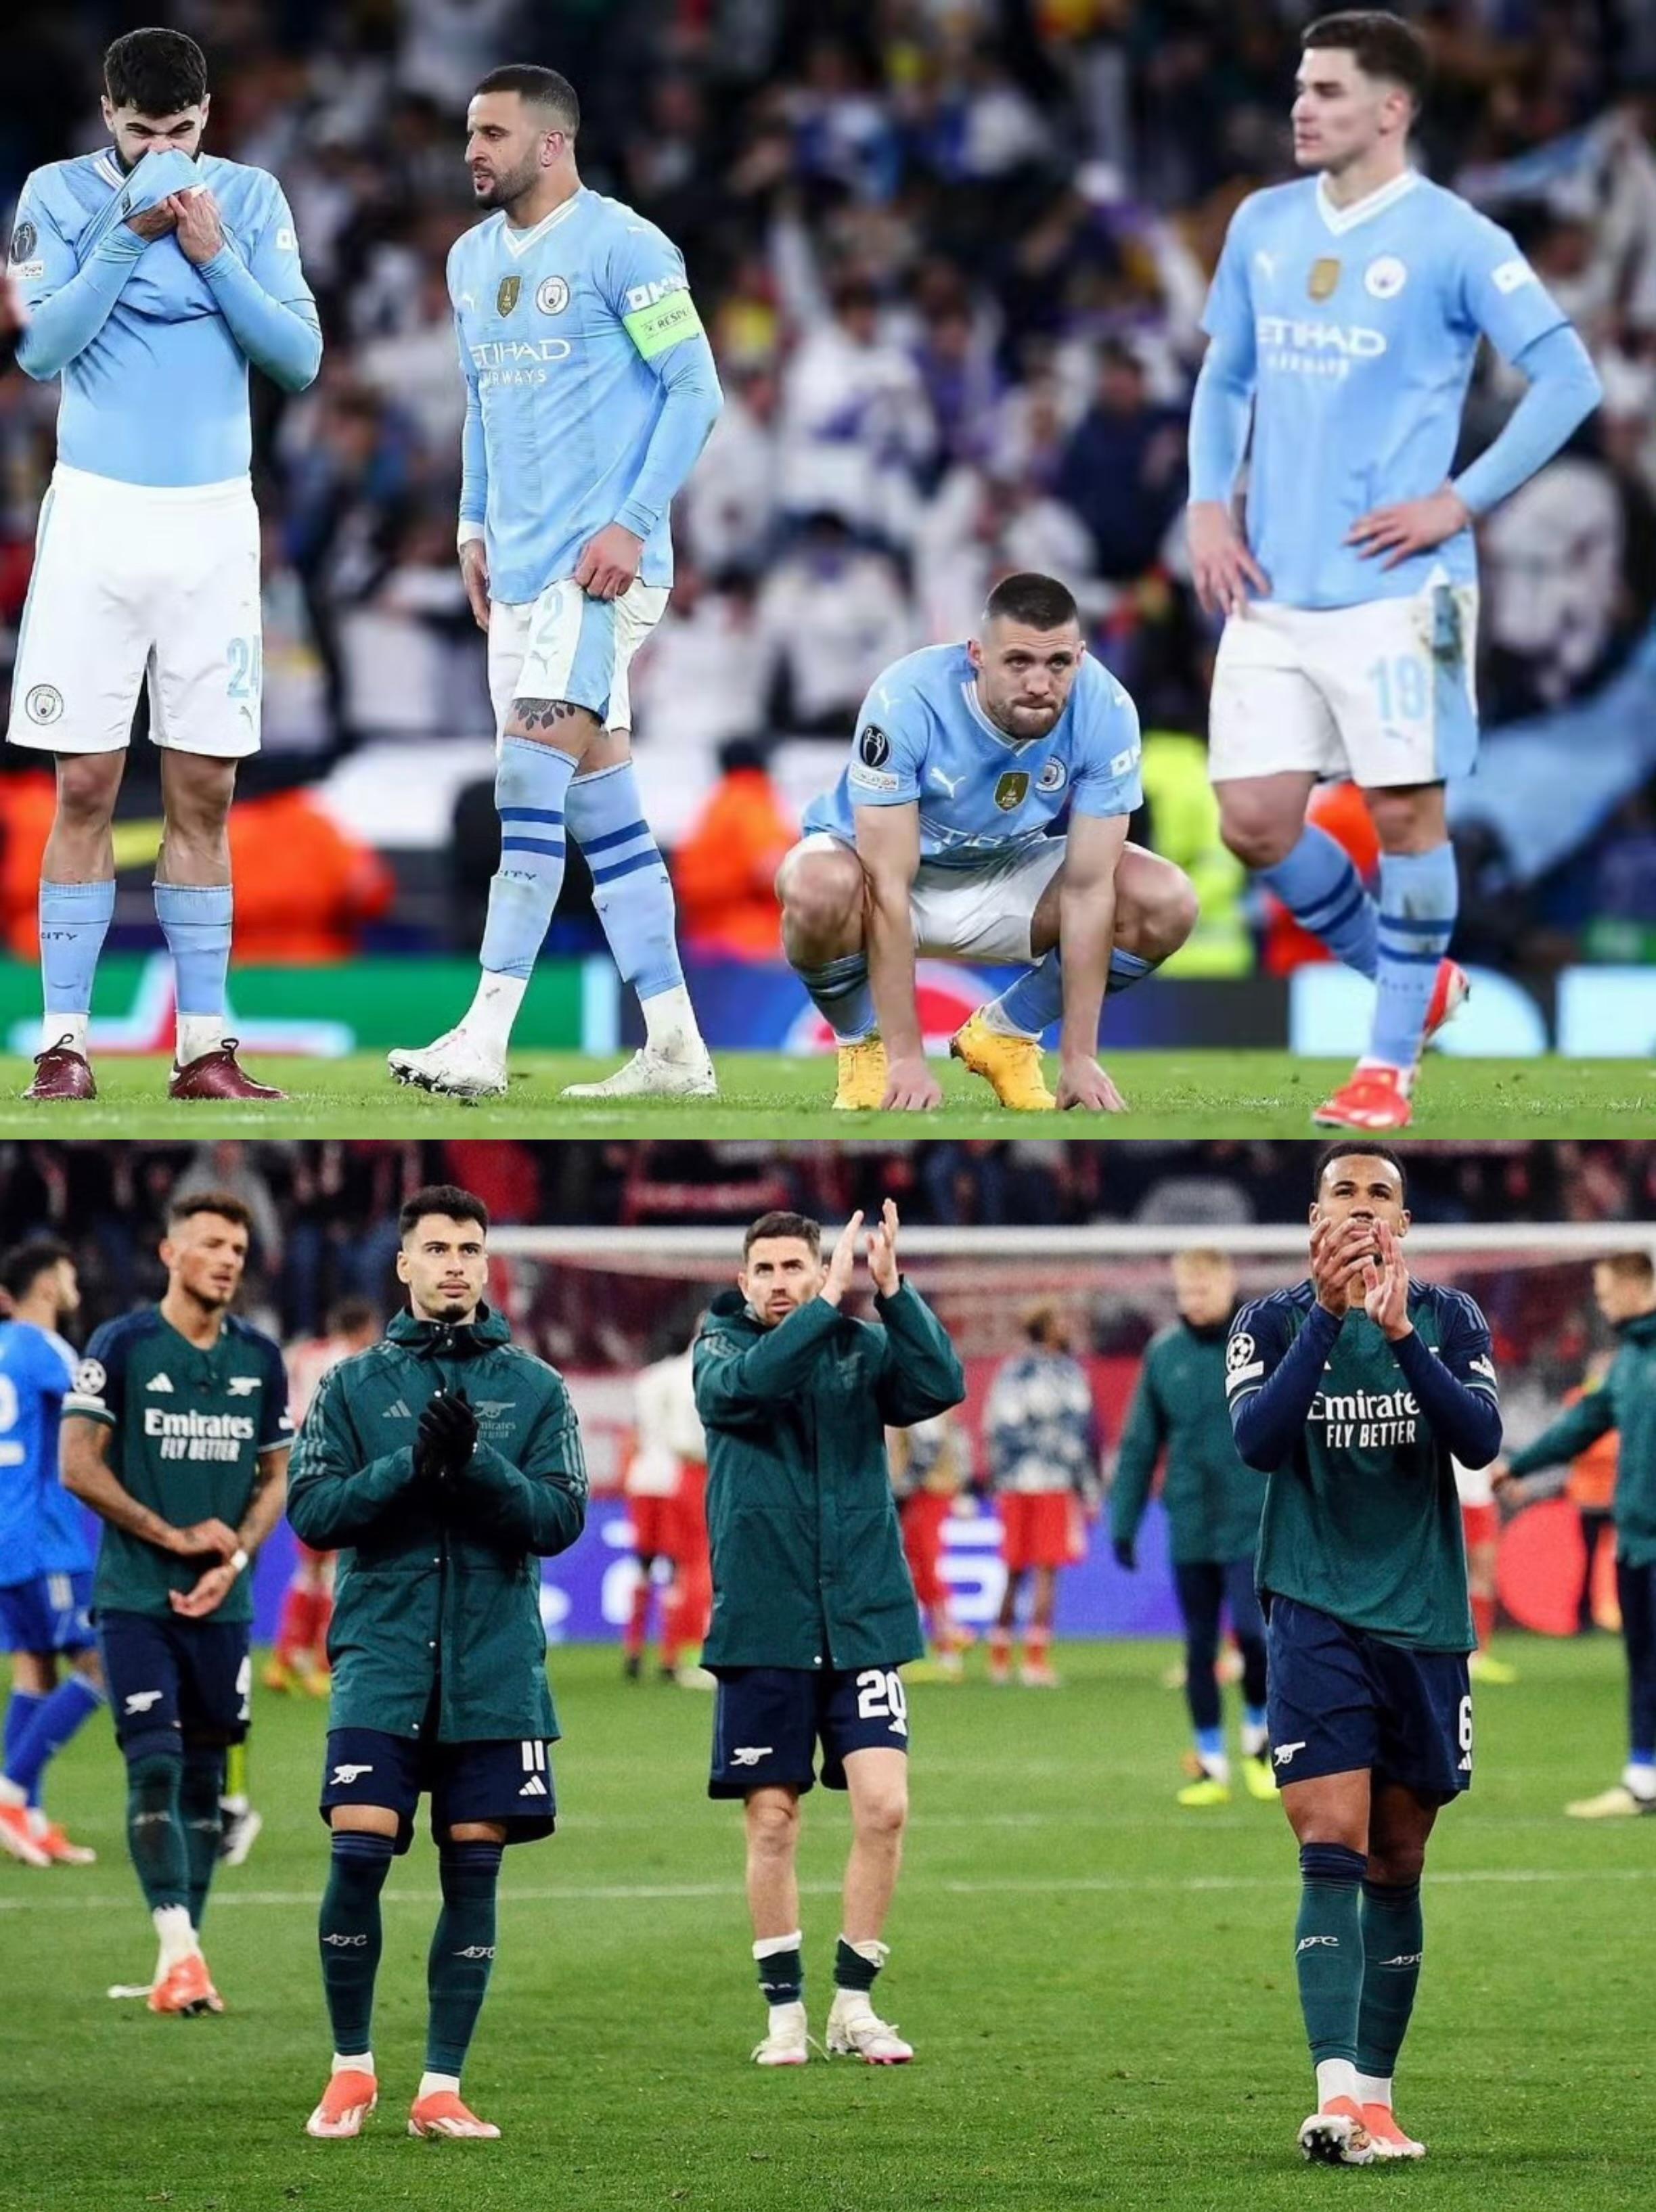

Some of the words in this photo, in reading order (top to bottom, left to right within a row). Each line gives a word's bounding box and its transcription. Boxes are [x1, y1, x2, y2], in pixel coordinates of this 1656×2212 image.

[1257, 315, 1387, 357] ETIHAD
[145, 1408, 254, 1440] Emirates
[1326, 1423, 1354, 1448] FLY
[1359, 1420, 1416, 1448] BETTER
[160, 1437, 188, 1460] FLY
[188, 1437, 241, 1462] BETTER
[856, 1669, 908, 1719] 20
[1458, 1695, 1473, 1751] 6
